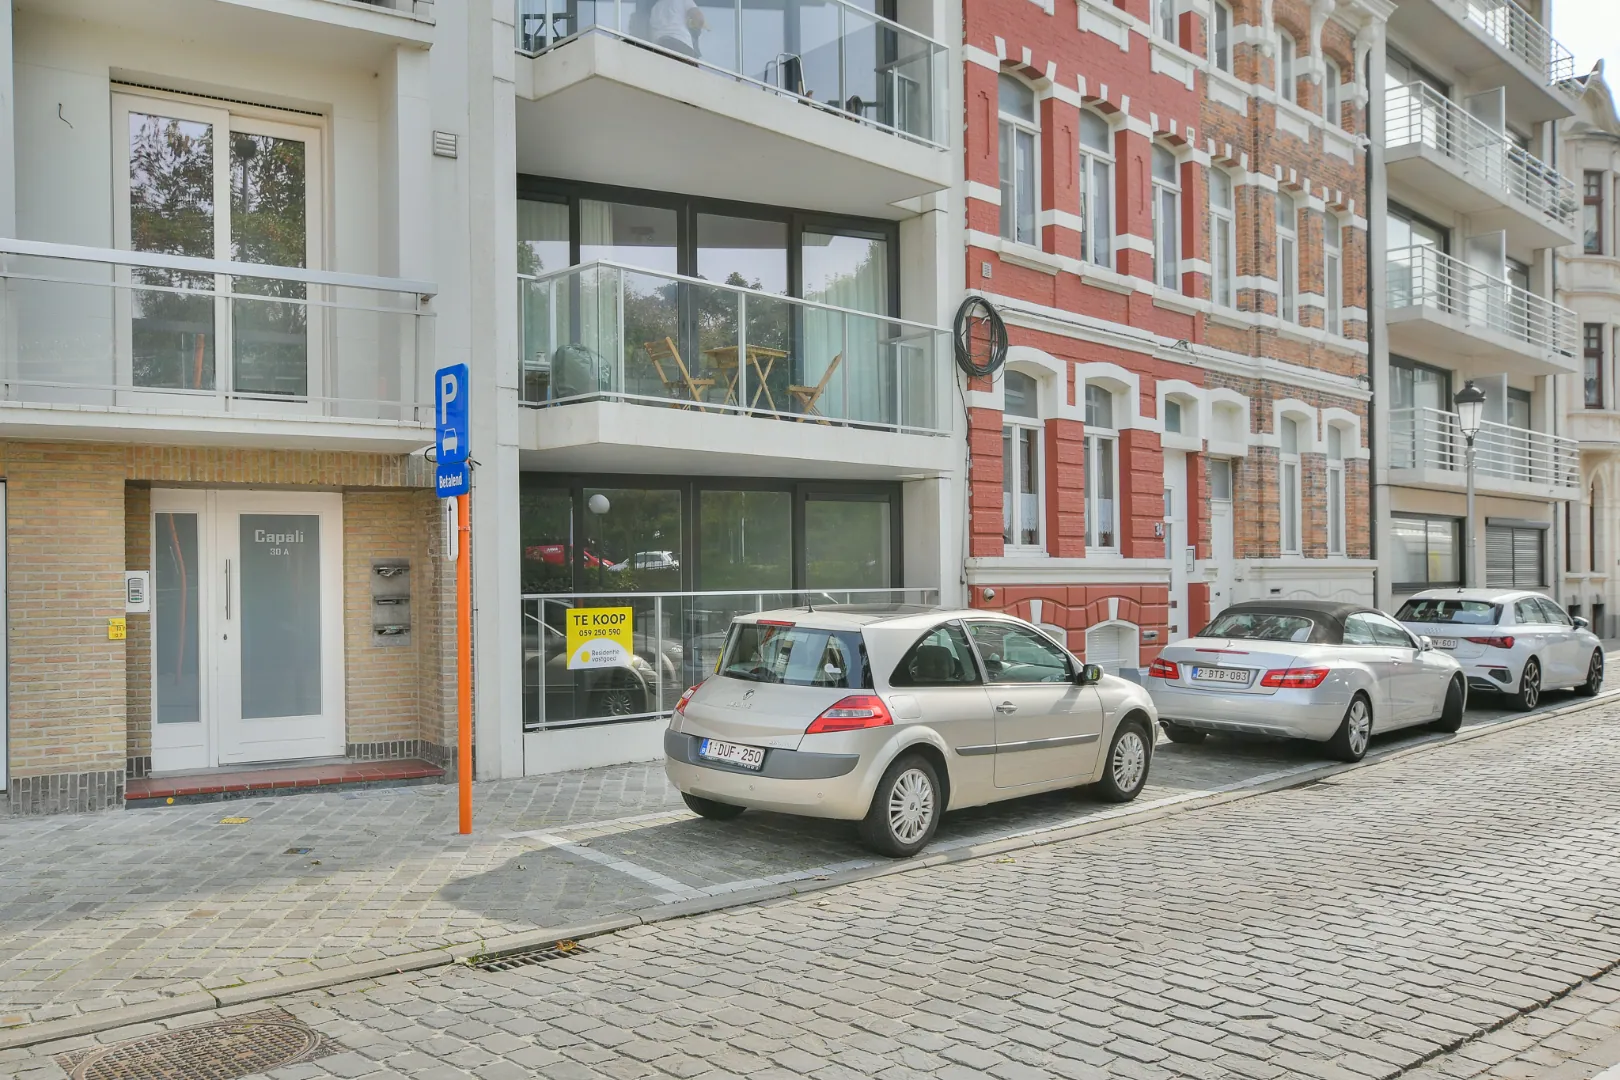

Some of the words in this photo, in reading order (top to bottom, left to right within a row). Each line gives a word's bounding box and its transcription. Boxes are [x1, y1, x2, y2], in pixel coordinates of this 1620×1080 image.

[441, 373, 458, 425] P
[438, 472, 463, 489] Betalend
[254, 529, 304, 545] Capali
[270, 548, 282, 556] 30
[283, 548, 290, 556] A
[573, 615, 588, 626] TE
[592, 613, 626, 625] KOOP
[578, 629, 592, 637] 059
[608, 628, 621, 636] 590
[1198, 669, 1247, 681] 2-BTB-083
